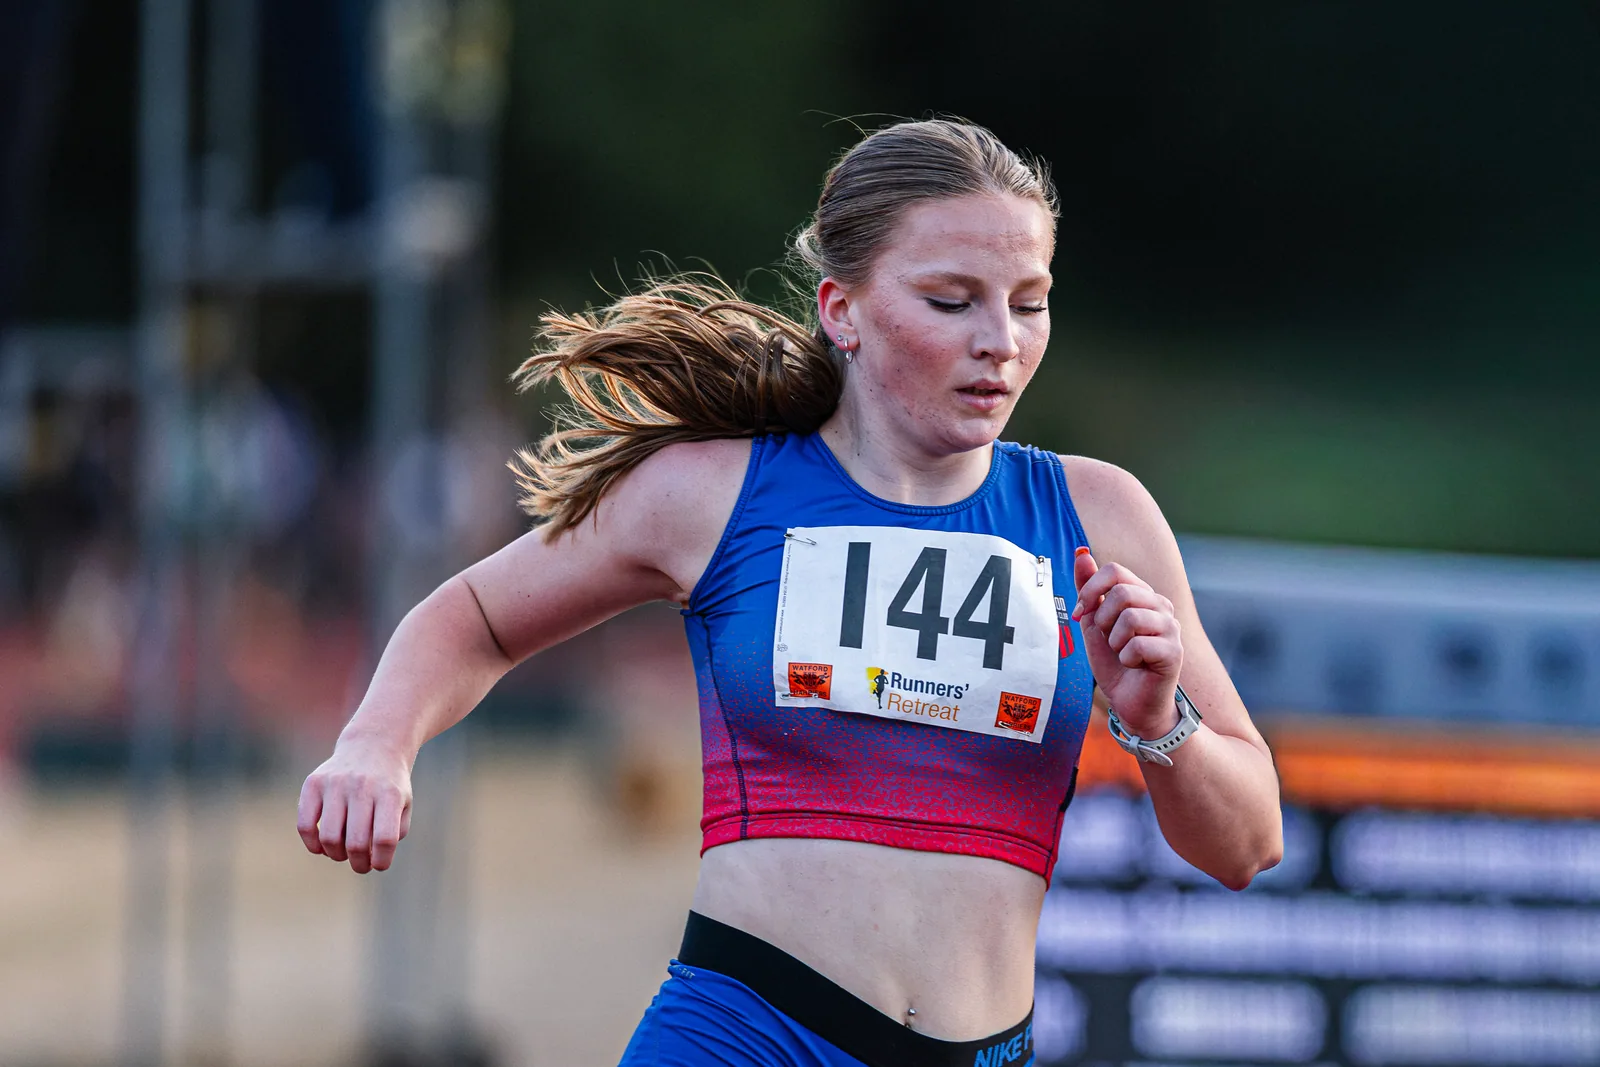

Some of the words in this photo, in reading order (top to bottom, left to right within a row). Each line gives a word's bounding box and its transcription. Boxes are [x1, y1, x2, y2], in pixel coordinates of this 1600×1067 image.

[839, 542, 1015, 671] 144
[890, 671, 970, 700] Runners'
[1004, 695, 1037, 705] WATFORD
[887, 692, 961, 722] Retreat
[974, 1032, 1024, 1067] NIKE
